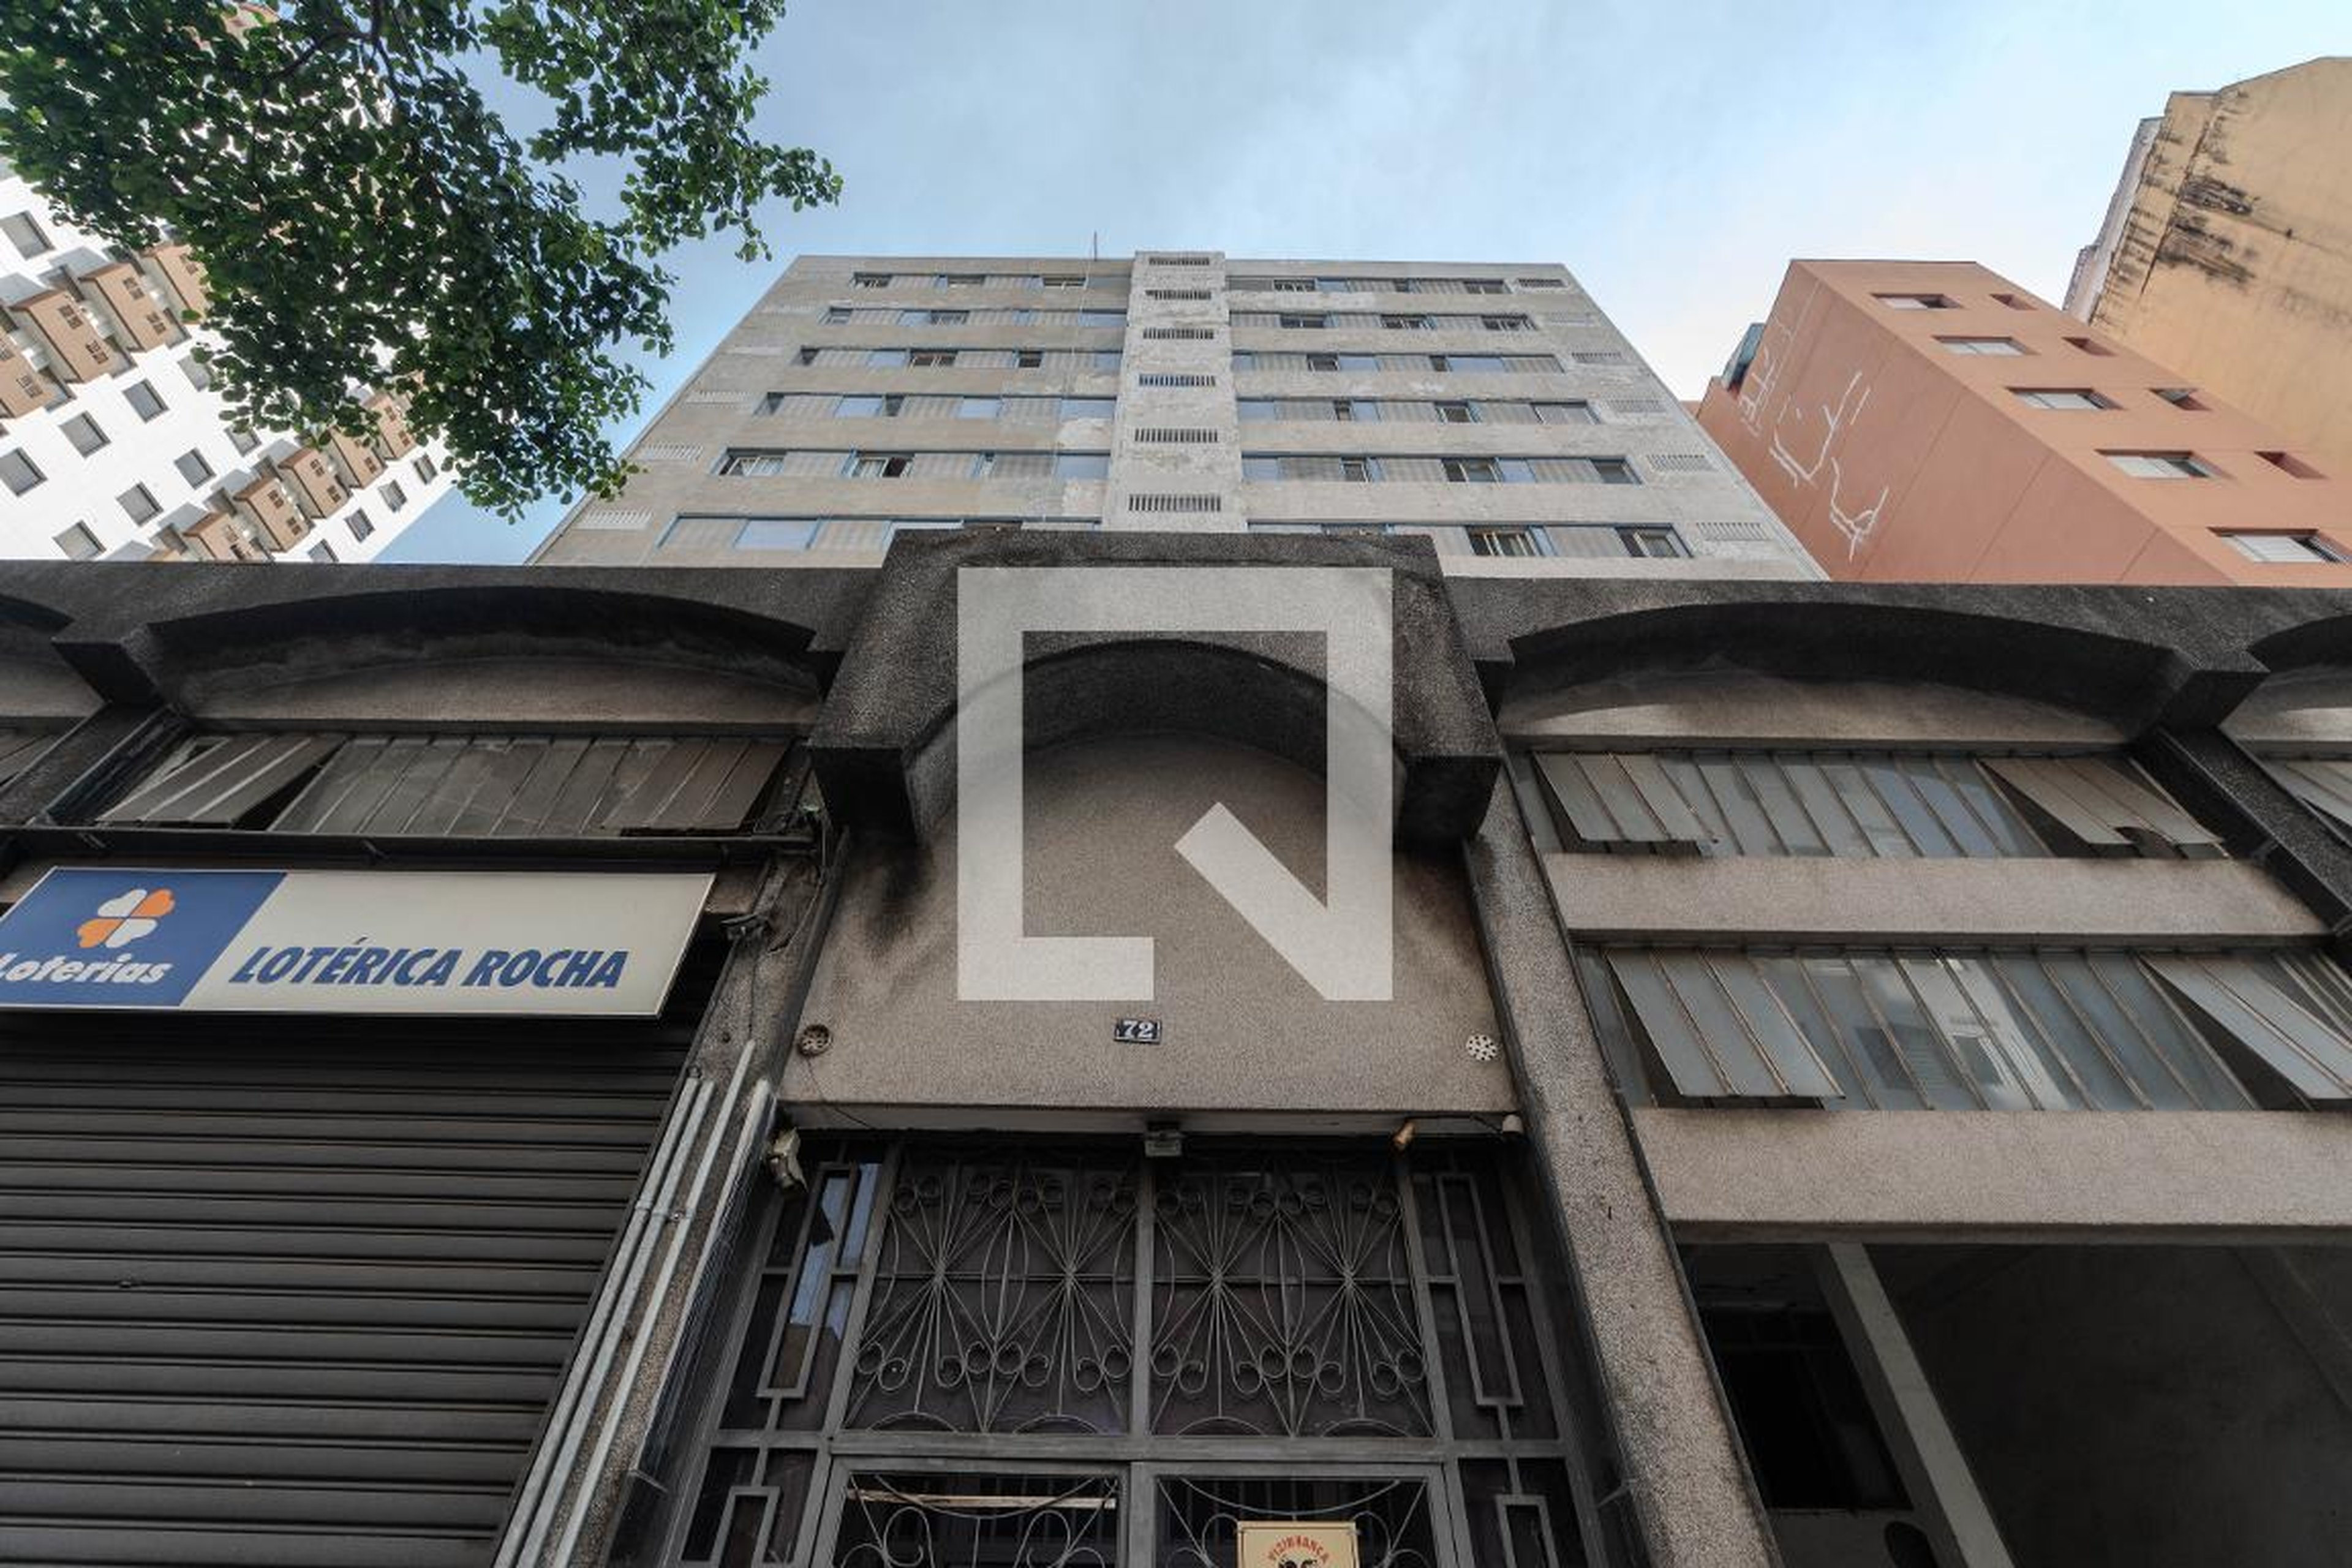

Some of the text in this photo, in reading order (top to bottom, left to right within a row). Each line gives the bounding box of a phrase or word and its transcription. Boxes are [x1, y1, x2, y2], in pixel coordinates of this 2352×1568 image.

[228, 937, 628, 989] LOTÉRICA ROCHA
[1123, 1020, 1154, 1039] 72
